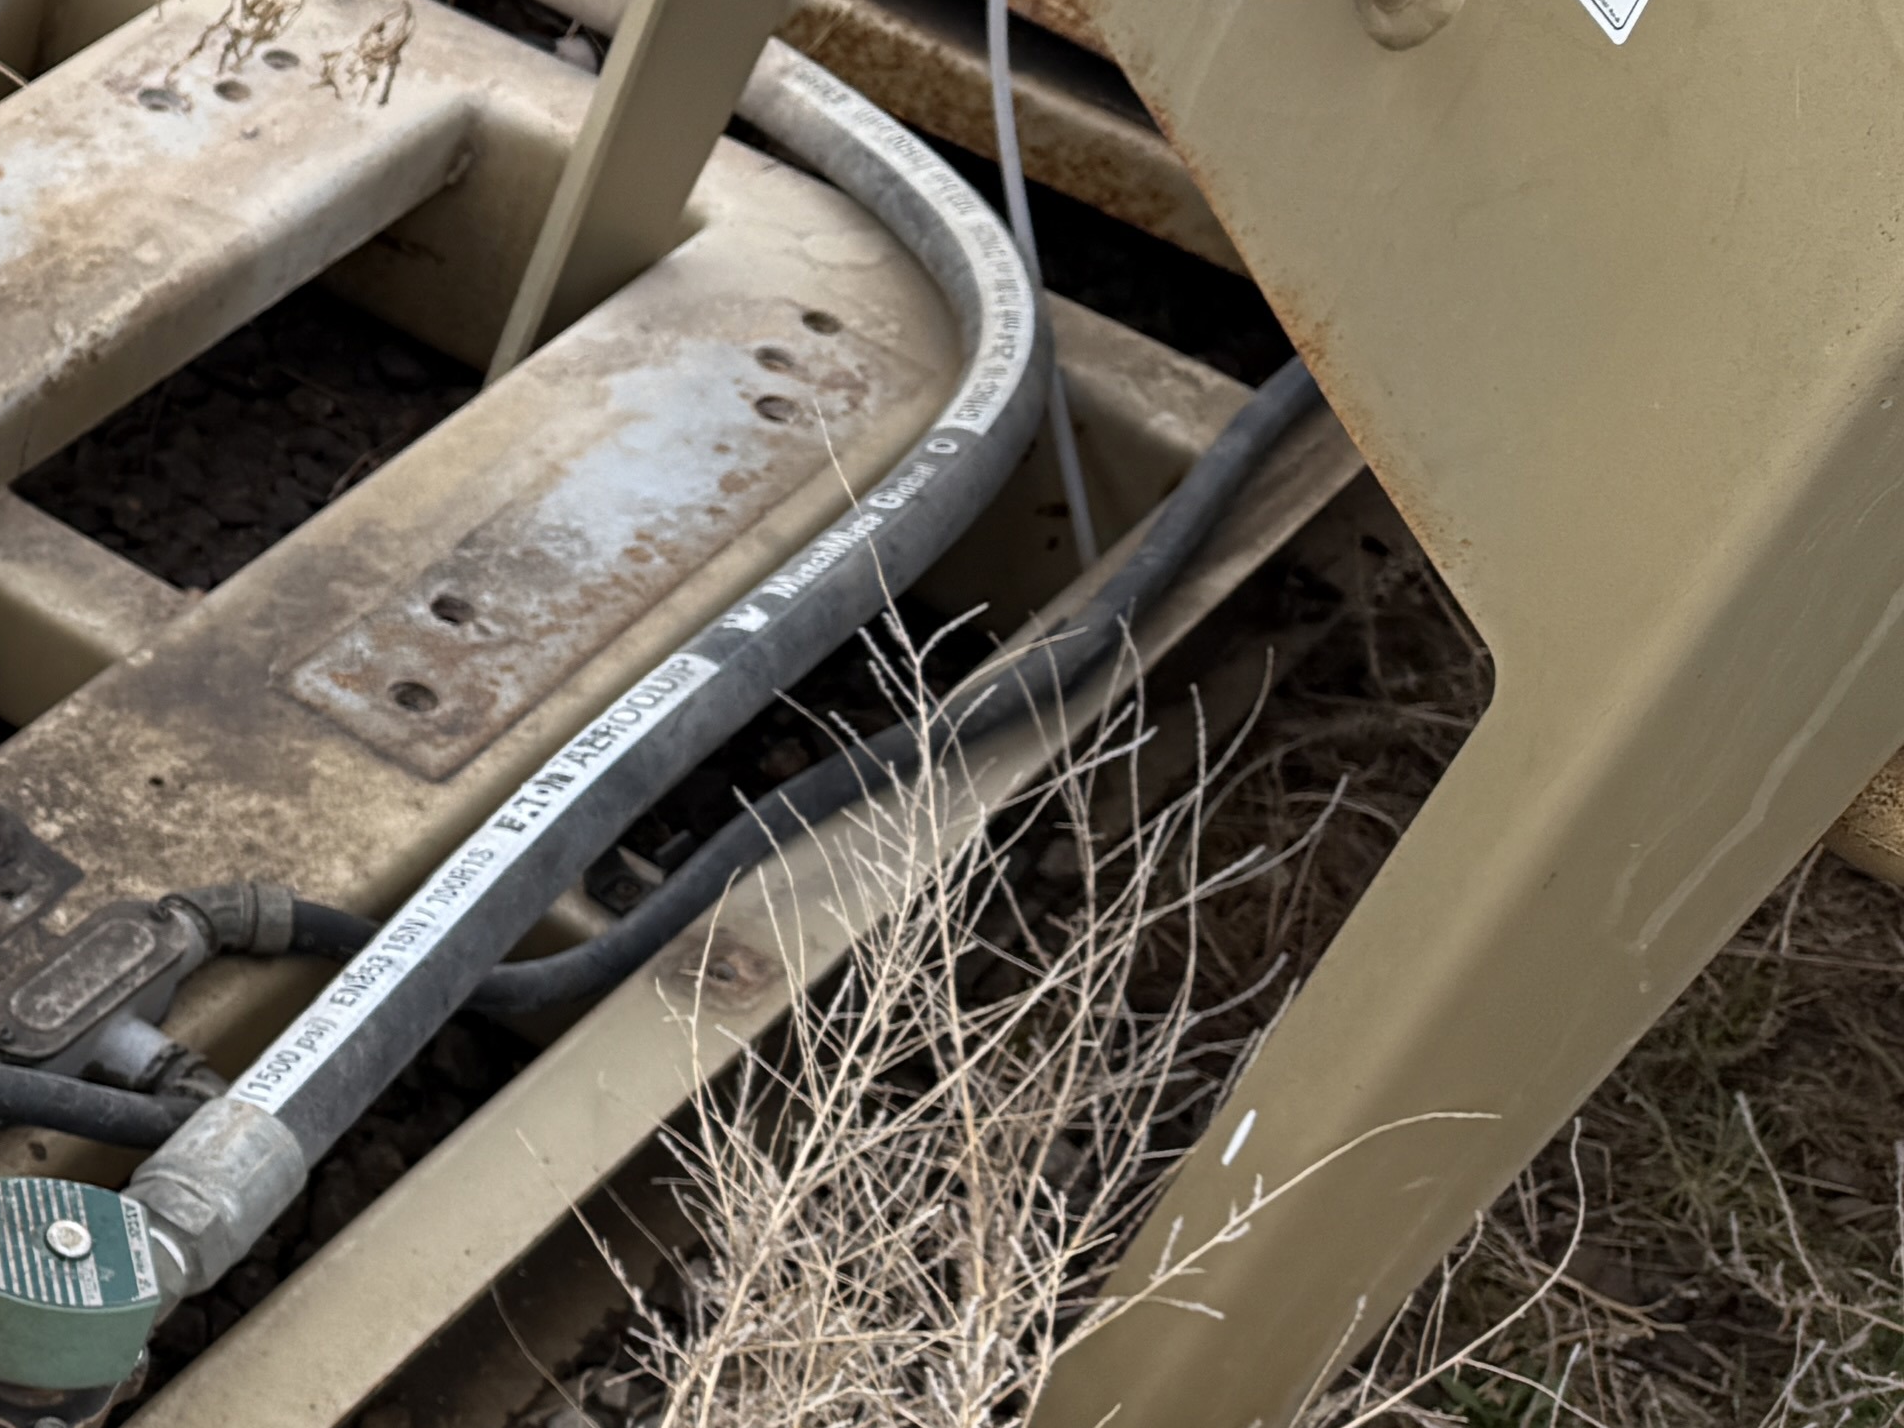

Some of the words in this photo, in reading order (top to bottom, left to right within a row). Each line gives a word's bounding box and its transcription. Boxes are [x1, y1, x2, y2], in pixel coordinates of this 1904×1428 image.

[239, 1049, 302, 1104] (1500
[296, 1014, 339, 1054] psi)
[570, 658, 692, 769] AEROQUIP
